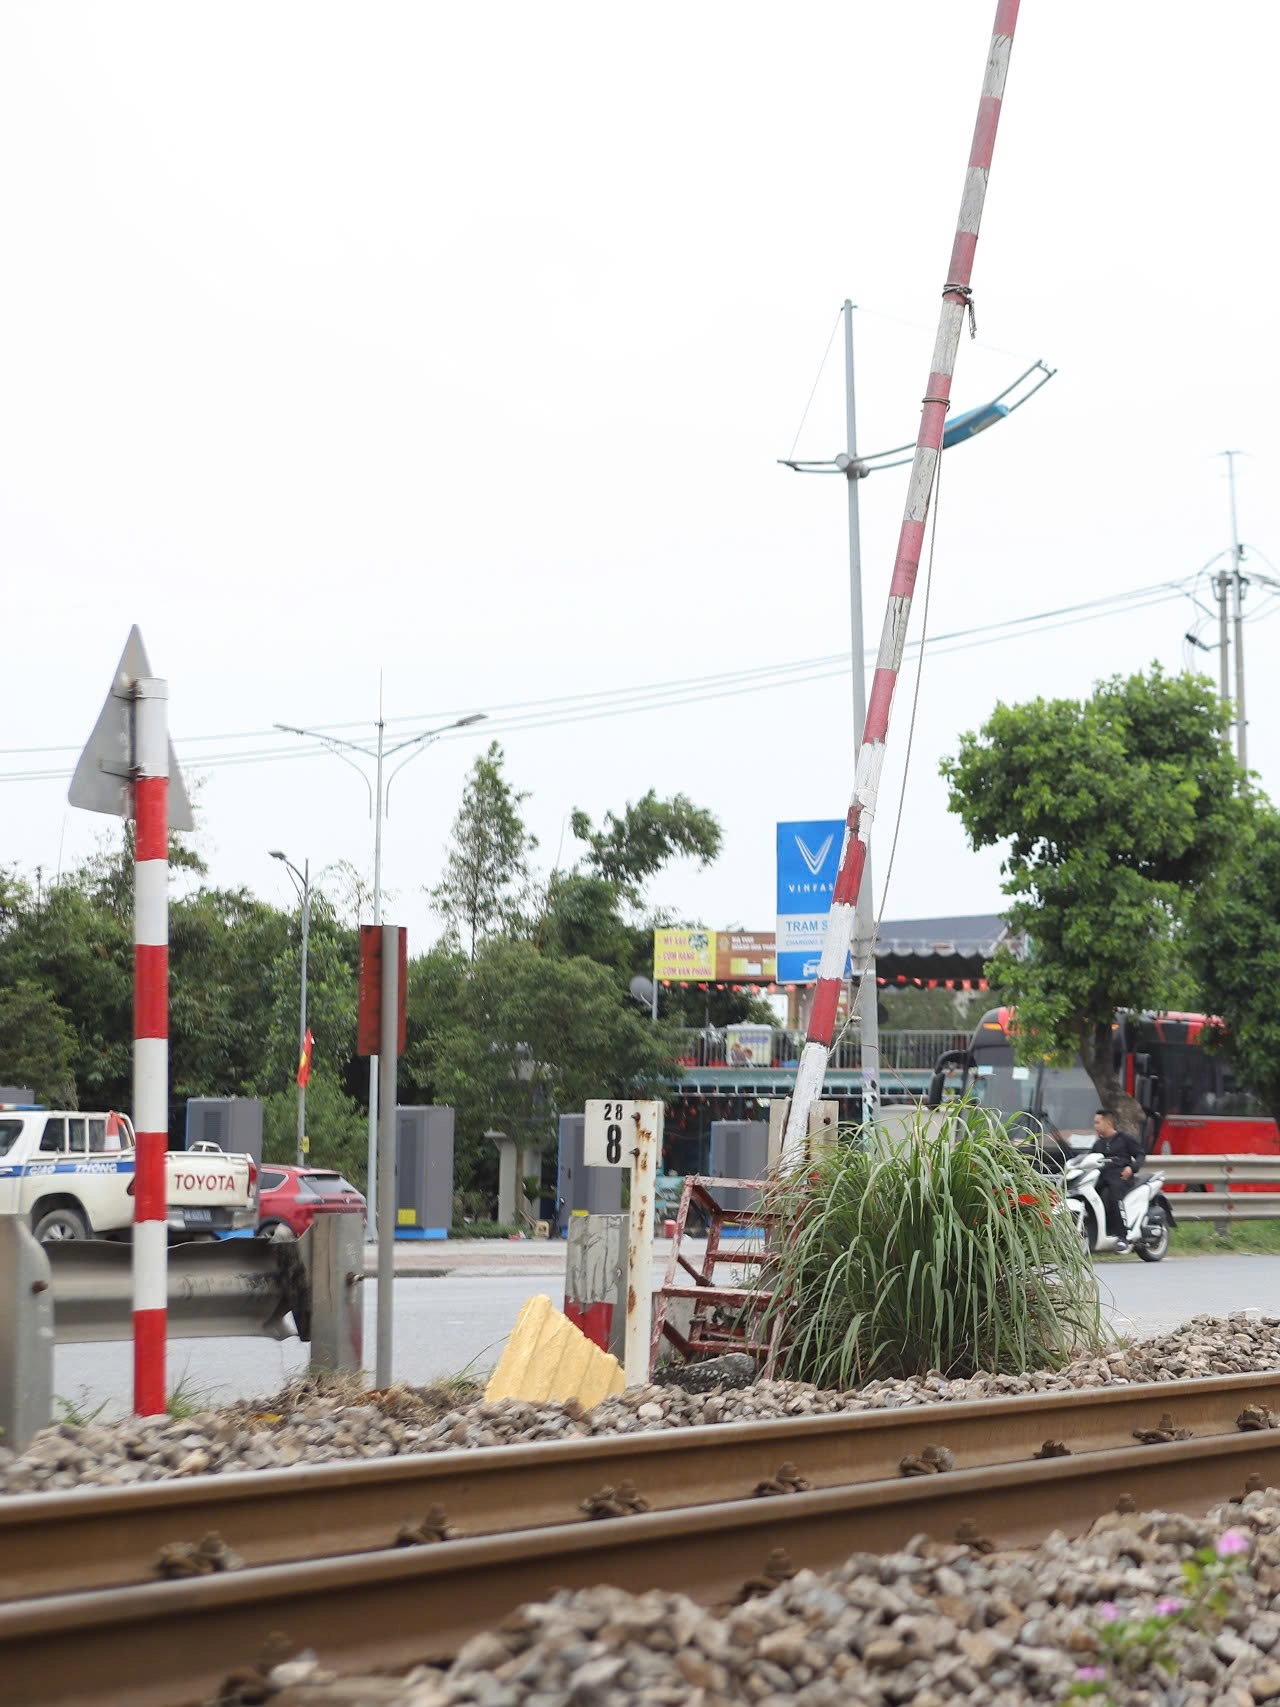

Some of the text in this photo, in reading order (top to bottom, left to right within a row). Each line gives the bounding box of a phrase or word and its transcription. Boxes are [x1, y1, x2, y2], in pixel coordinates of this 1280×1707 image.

[788, 883, 834, 893] VINFAS
[604, 1103, 623, 1121] 28
[606, 1124, 621, 1164] 8
[174, 1174, 236, 1191] TOYOTA
